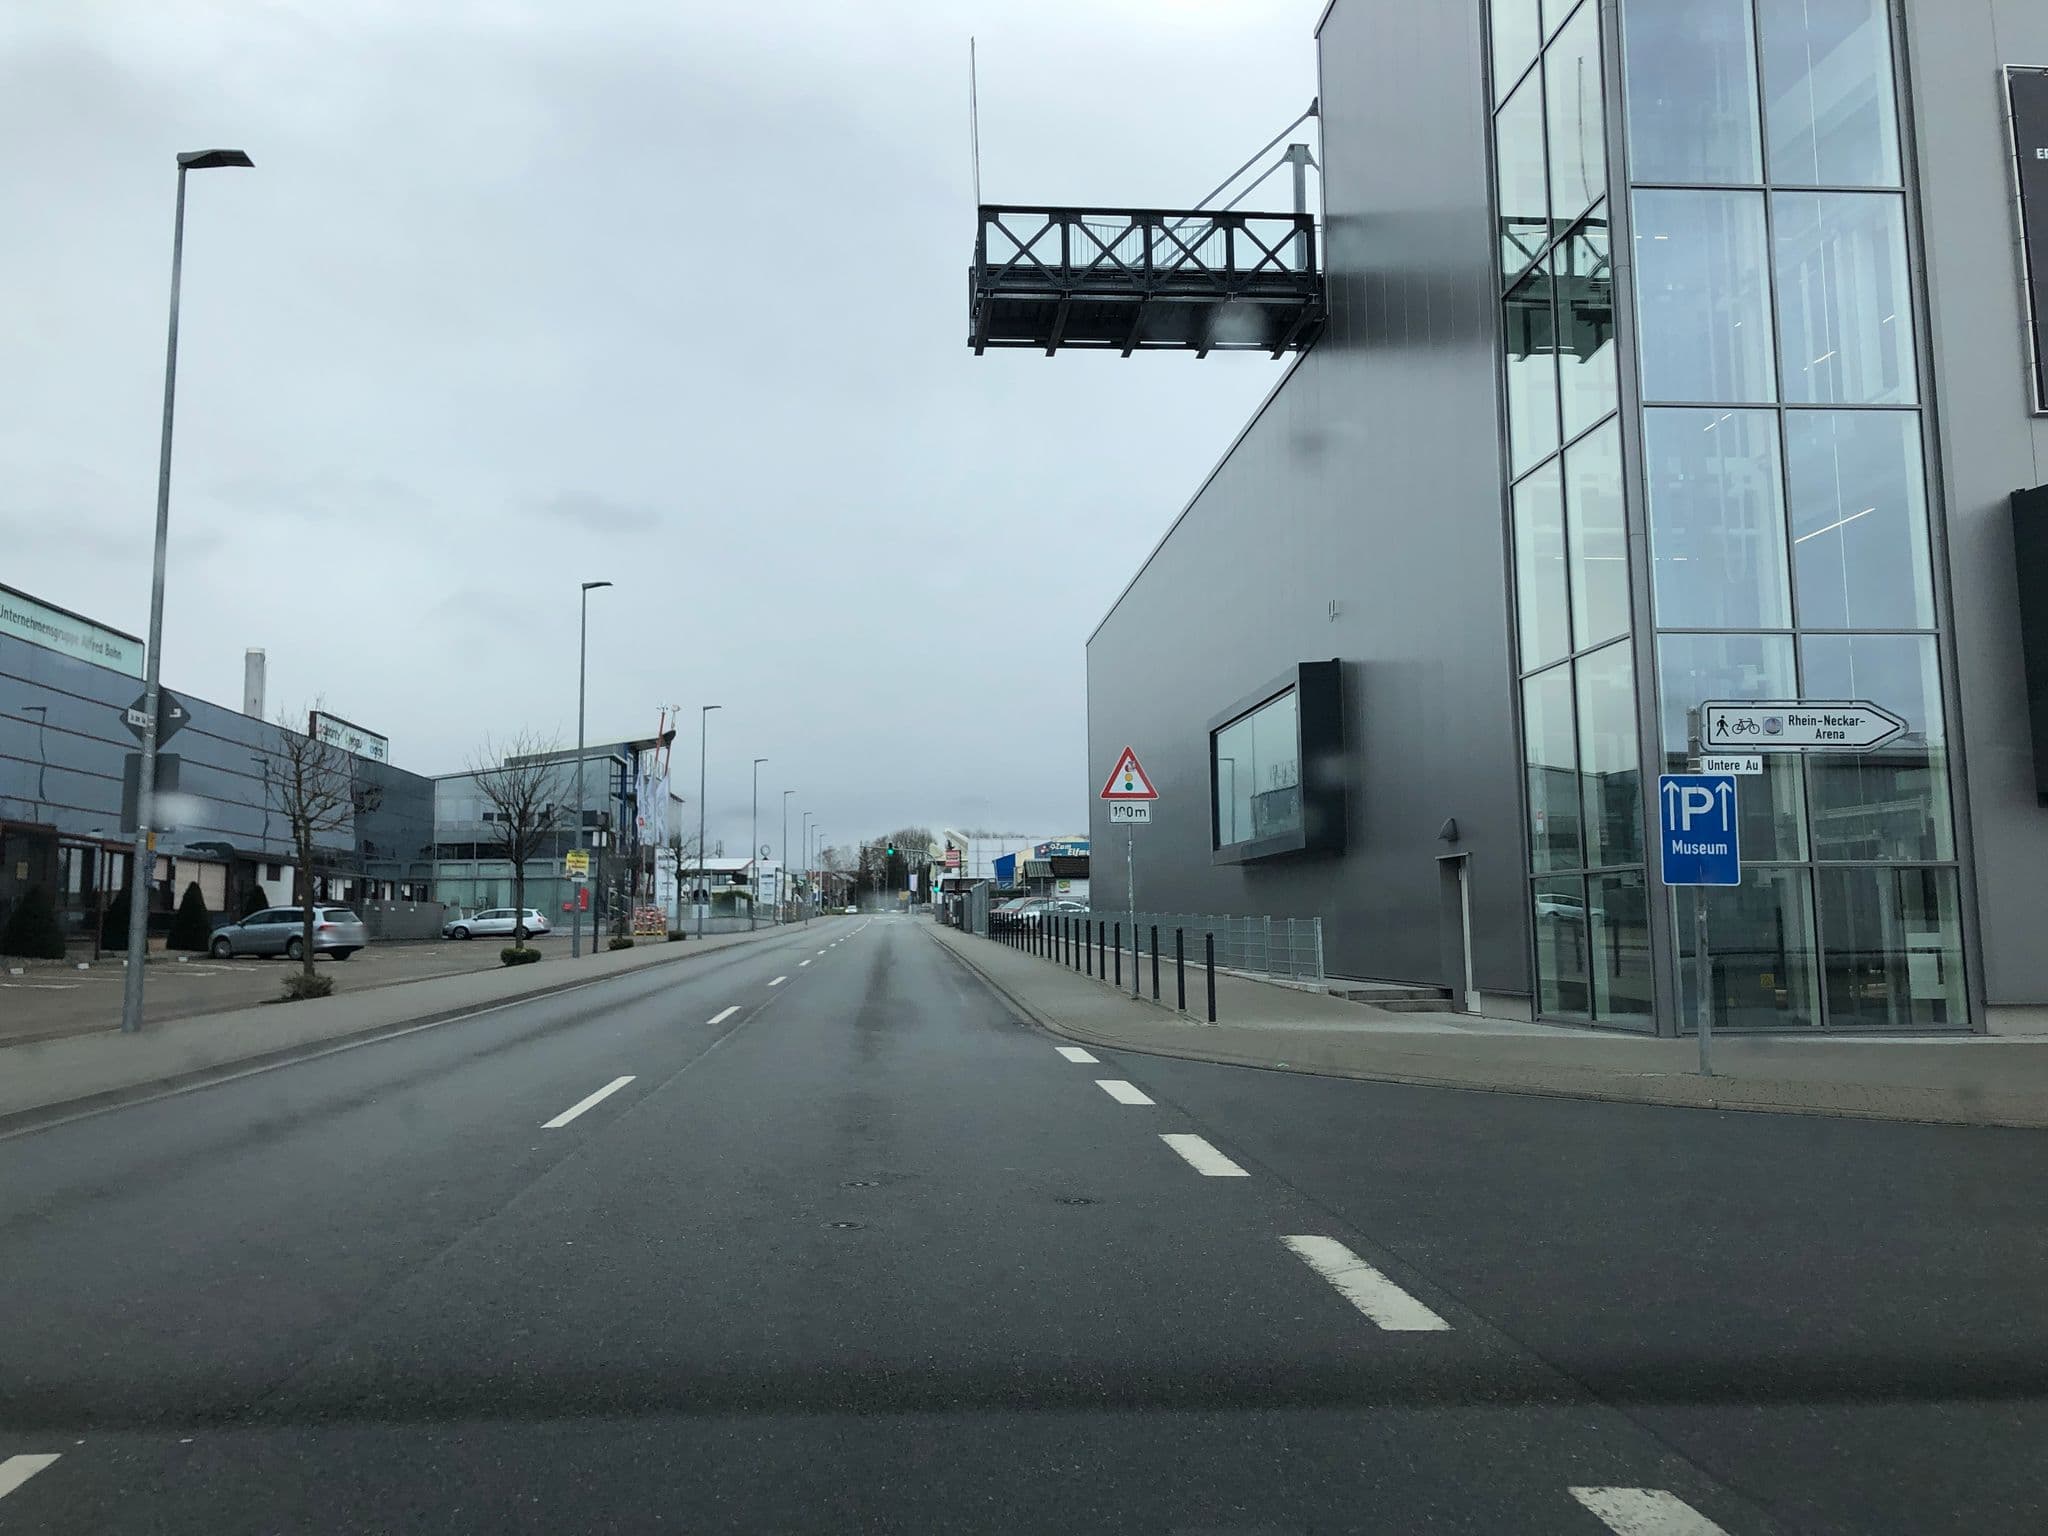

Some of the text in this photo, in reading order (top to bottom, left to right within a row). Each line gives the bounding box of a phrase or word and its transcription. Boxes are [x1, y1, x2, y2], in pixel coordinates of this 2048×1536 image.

[1788, 714, 1866, 727] Rhein-Neckar-
[1815, 728, 1845, 739] Arena
[1707, 759, 1759, 771] Untere Au
[1681, 786, 1715, 831] P
[1672, 839, 1728, 855] Museum
